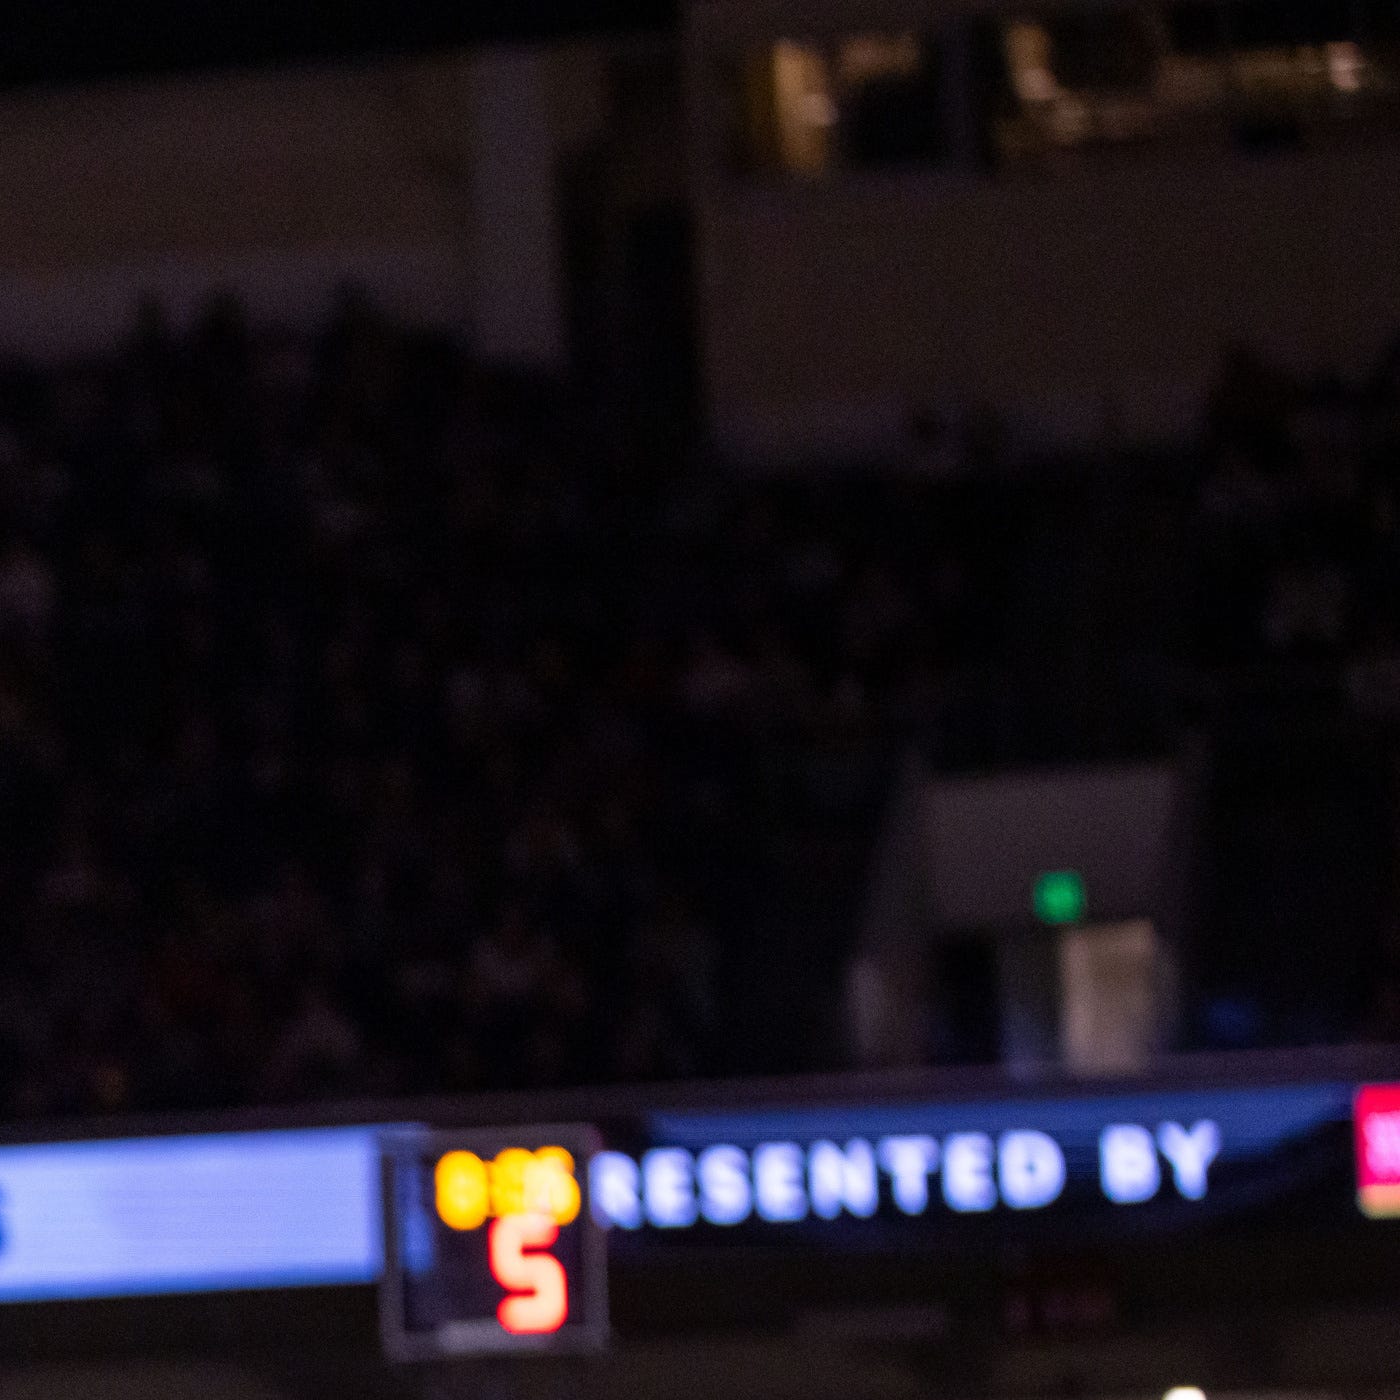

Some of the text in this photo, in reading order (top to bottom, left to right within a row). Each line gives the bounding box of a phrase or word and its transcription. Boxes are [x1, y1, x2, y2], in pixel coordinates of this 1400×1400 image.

[588, 1119, 1220, 1230] RESENTED BY
[487, 1210, 569, 1336] 5
